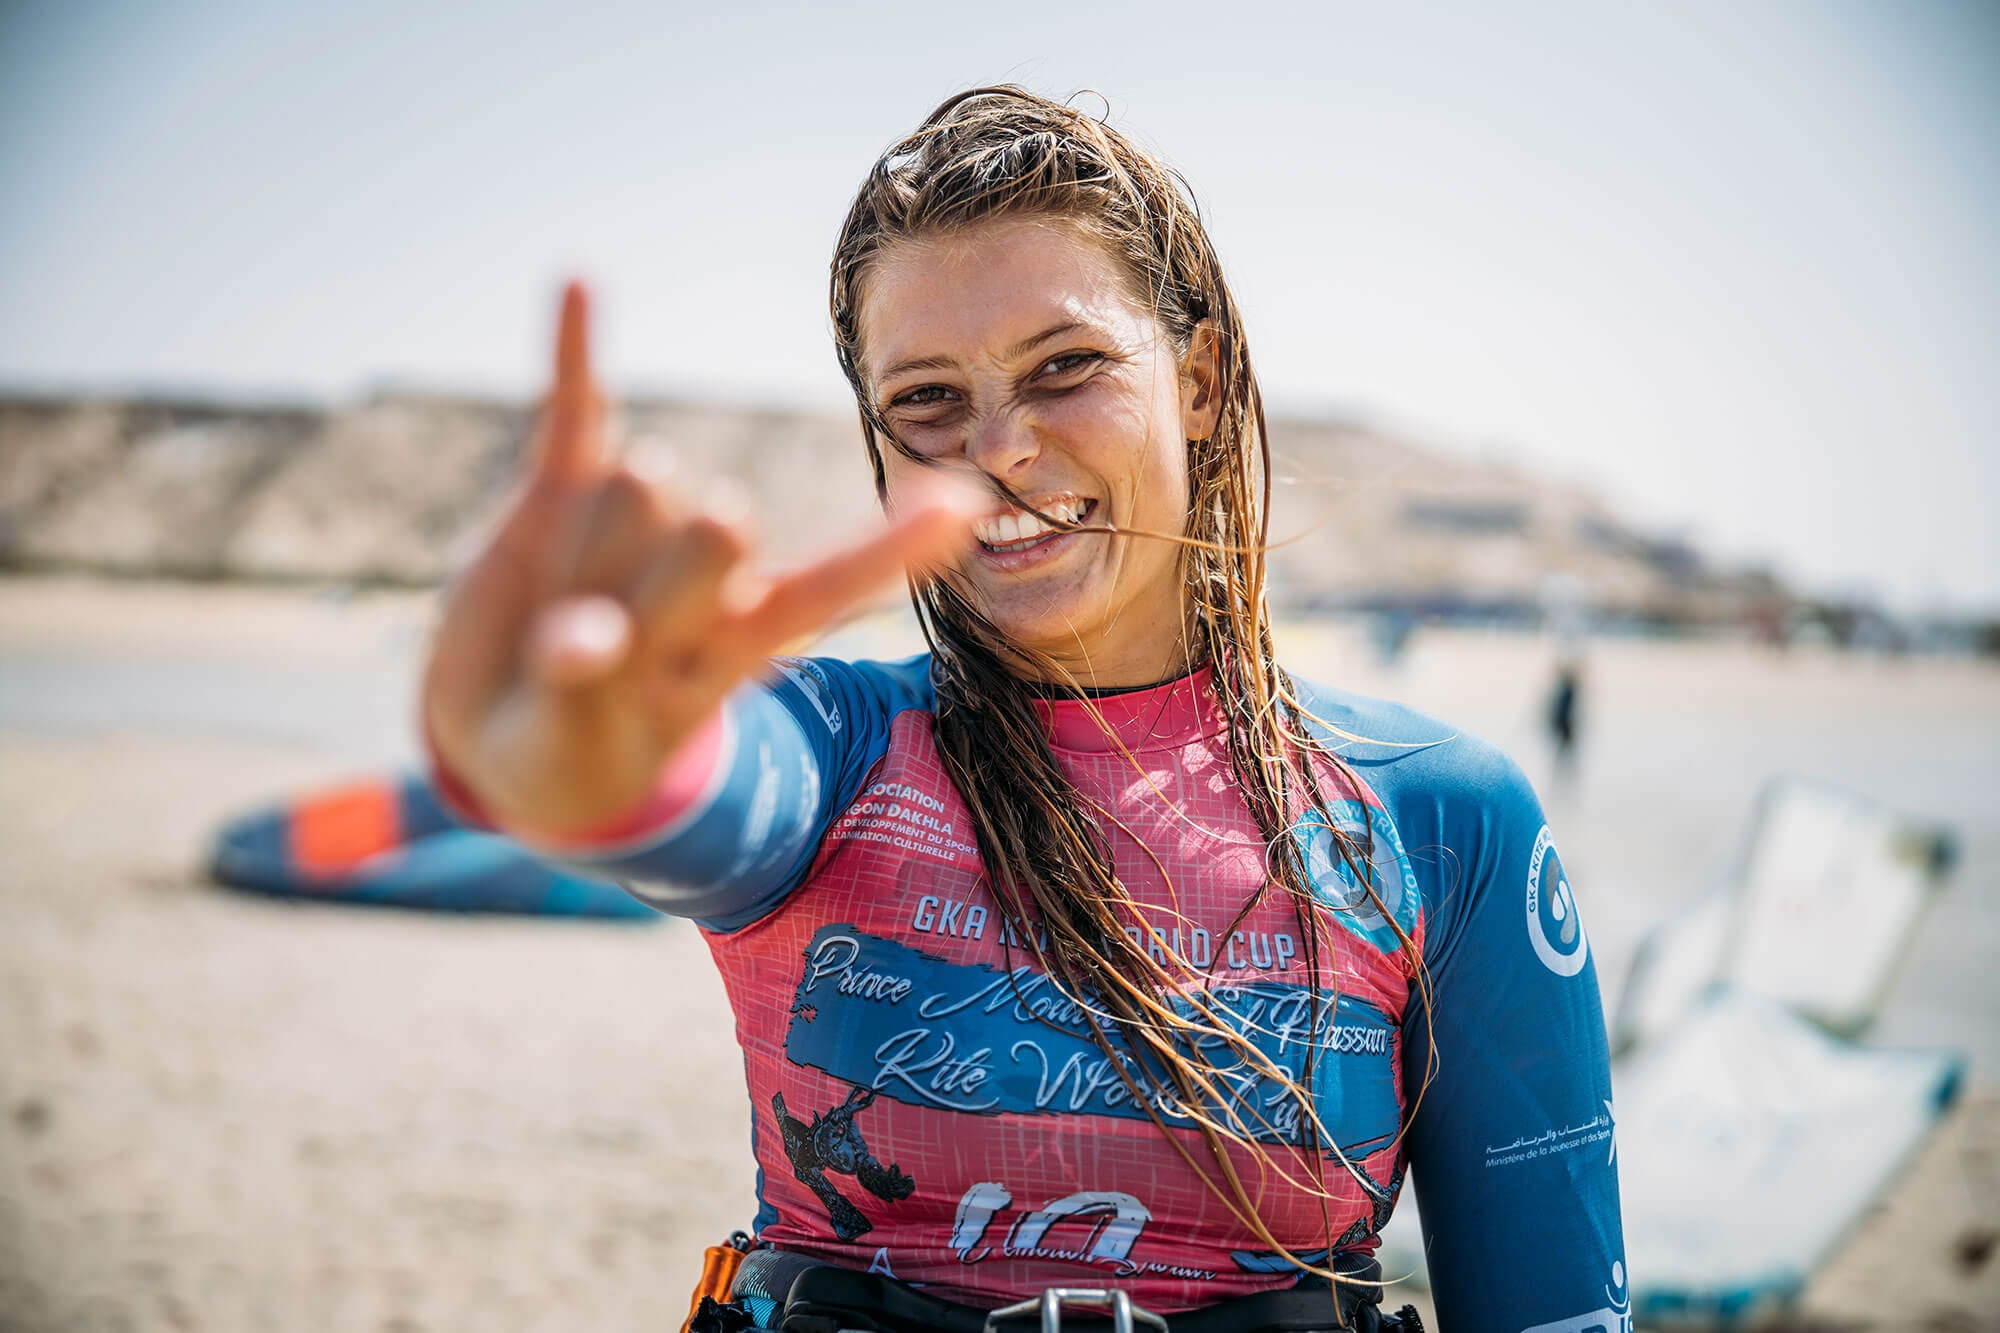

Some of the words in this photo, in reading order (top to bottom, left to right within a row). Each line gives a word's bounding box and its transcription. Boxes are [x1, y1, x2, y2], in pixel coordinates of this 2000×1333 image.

[845, 803, 886, 816] GON
[887, 802, 953, 836] DAKHLA
[893, 836, 956, 861] CULTURELLE
[927, 833, 943, 845] DU
[944, 838, 978, 856] SPORT
[1528, 877, 1537, 913] GKA
[912, 895, 988, 940] GKA
[1227, 932, 1296, 970] CUP
[806, 935, 913, 1004] Prince
[872, 1028, 999, 1111] Kite
